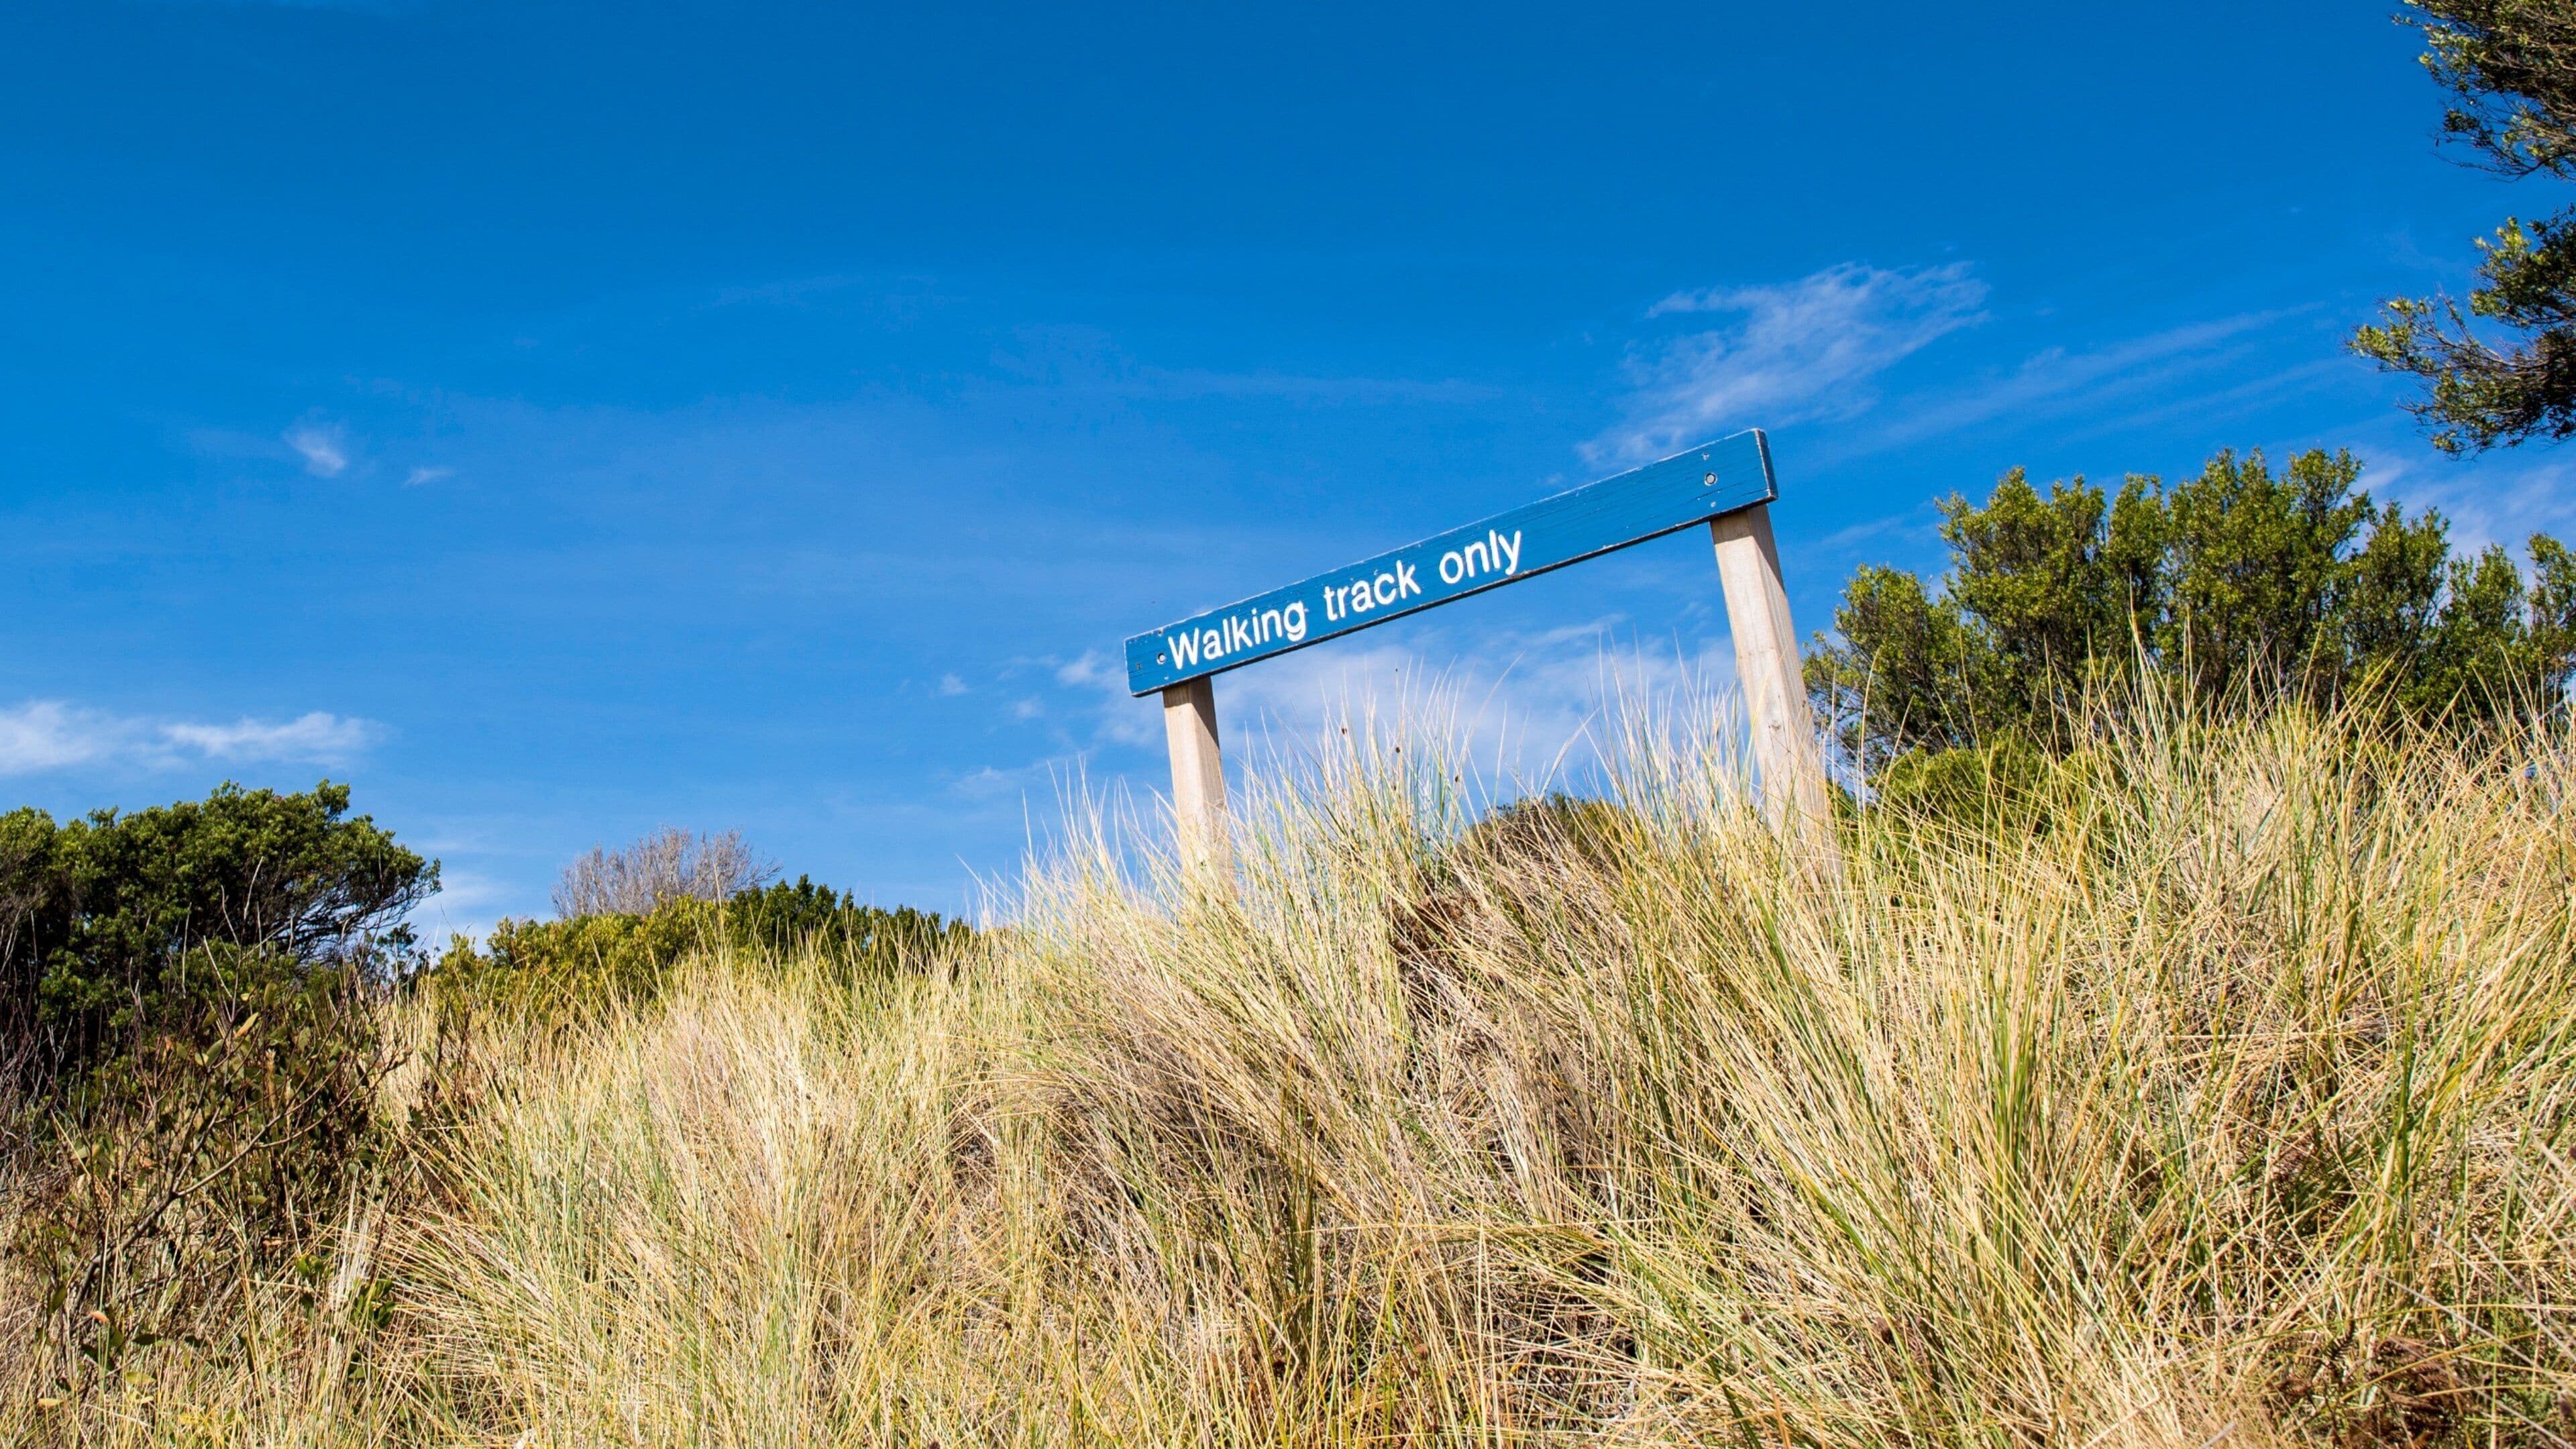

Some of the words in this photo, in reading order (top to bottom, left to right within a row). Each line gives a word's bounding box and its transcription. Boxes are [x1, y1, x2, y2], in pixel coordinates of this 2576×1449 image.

[1167, 600, 1307, 670] Walking
[1324, 559, 1421, 622] track
[1439, 529, 1521, 585] only
